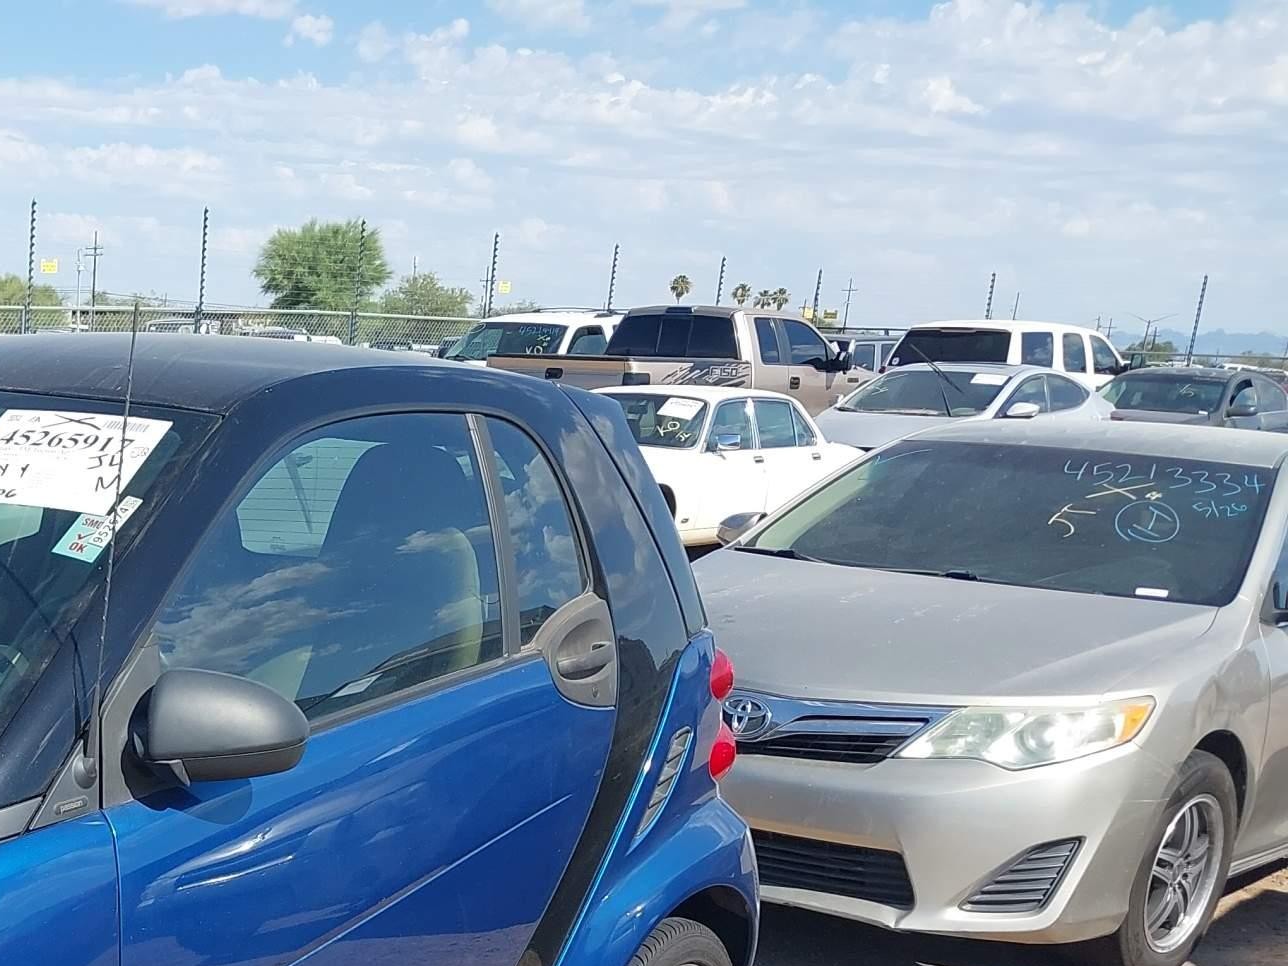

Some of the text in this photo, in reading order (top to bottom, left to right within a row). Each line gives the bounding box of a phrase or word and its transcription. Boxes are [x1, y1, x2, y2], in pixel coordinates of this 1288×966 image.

[656, 421, 680, 437] KO
[0, 428, 136, 454] 45265917
[1063, 459, 1266, 497] 45213334
[69, 541, 88, 554] OK
